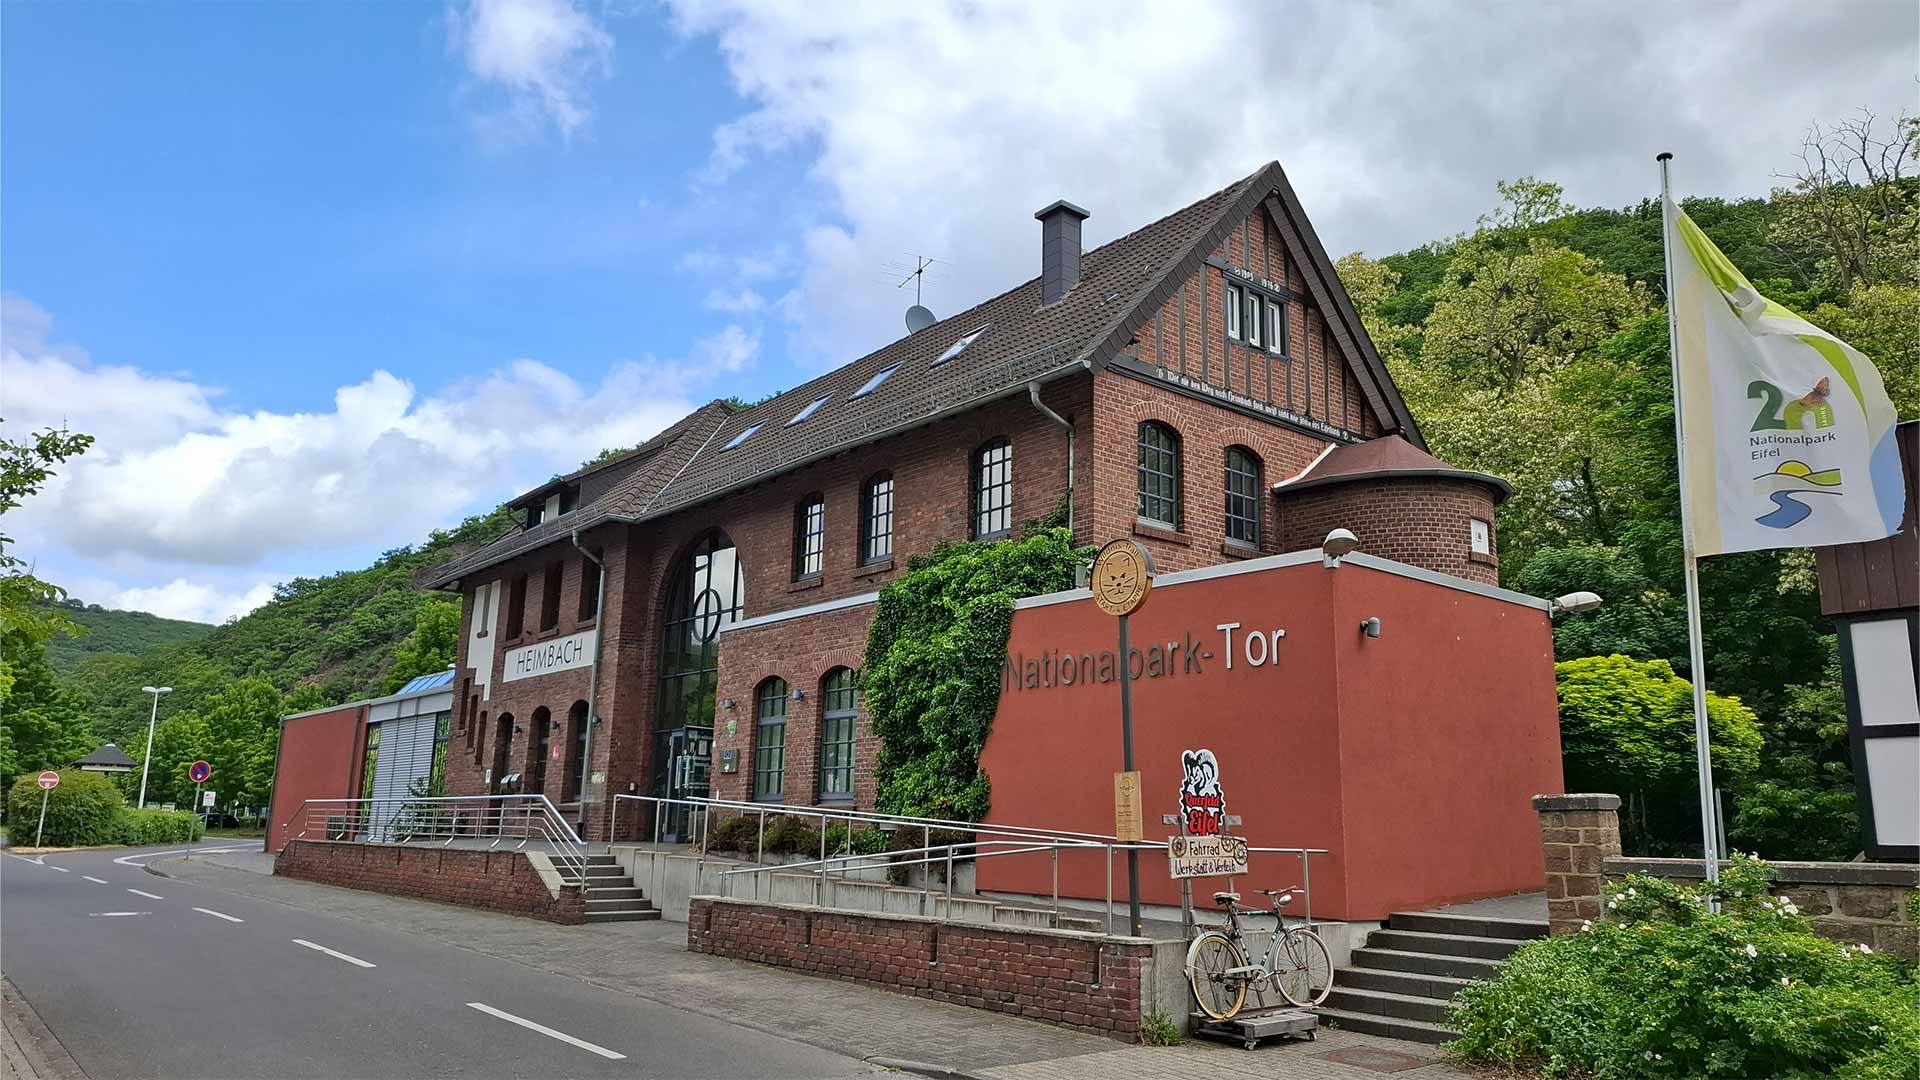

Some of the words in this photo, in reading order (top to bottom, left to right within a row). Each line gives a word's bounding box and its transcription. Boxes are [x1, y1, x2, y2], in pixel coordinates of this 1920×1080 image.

[1750, 432, 1836, 447] Nationalpark
[1751, 448, 1781, 460] Eifel
[516, 638, 583, 674] HEIMBACH
[1189, 810, 1219, 836] Eifel
[1189, 840, 1220, 856] Fahrrad
[1175, 858, 1208, 875] Werkstatt
